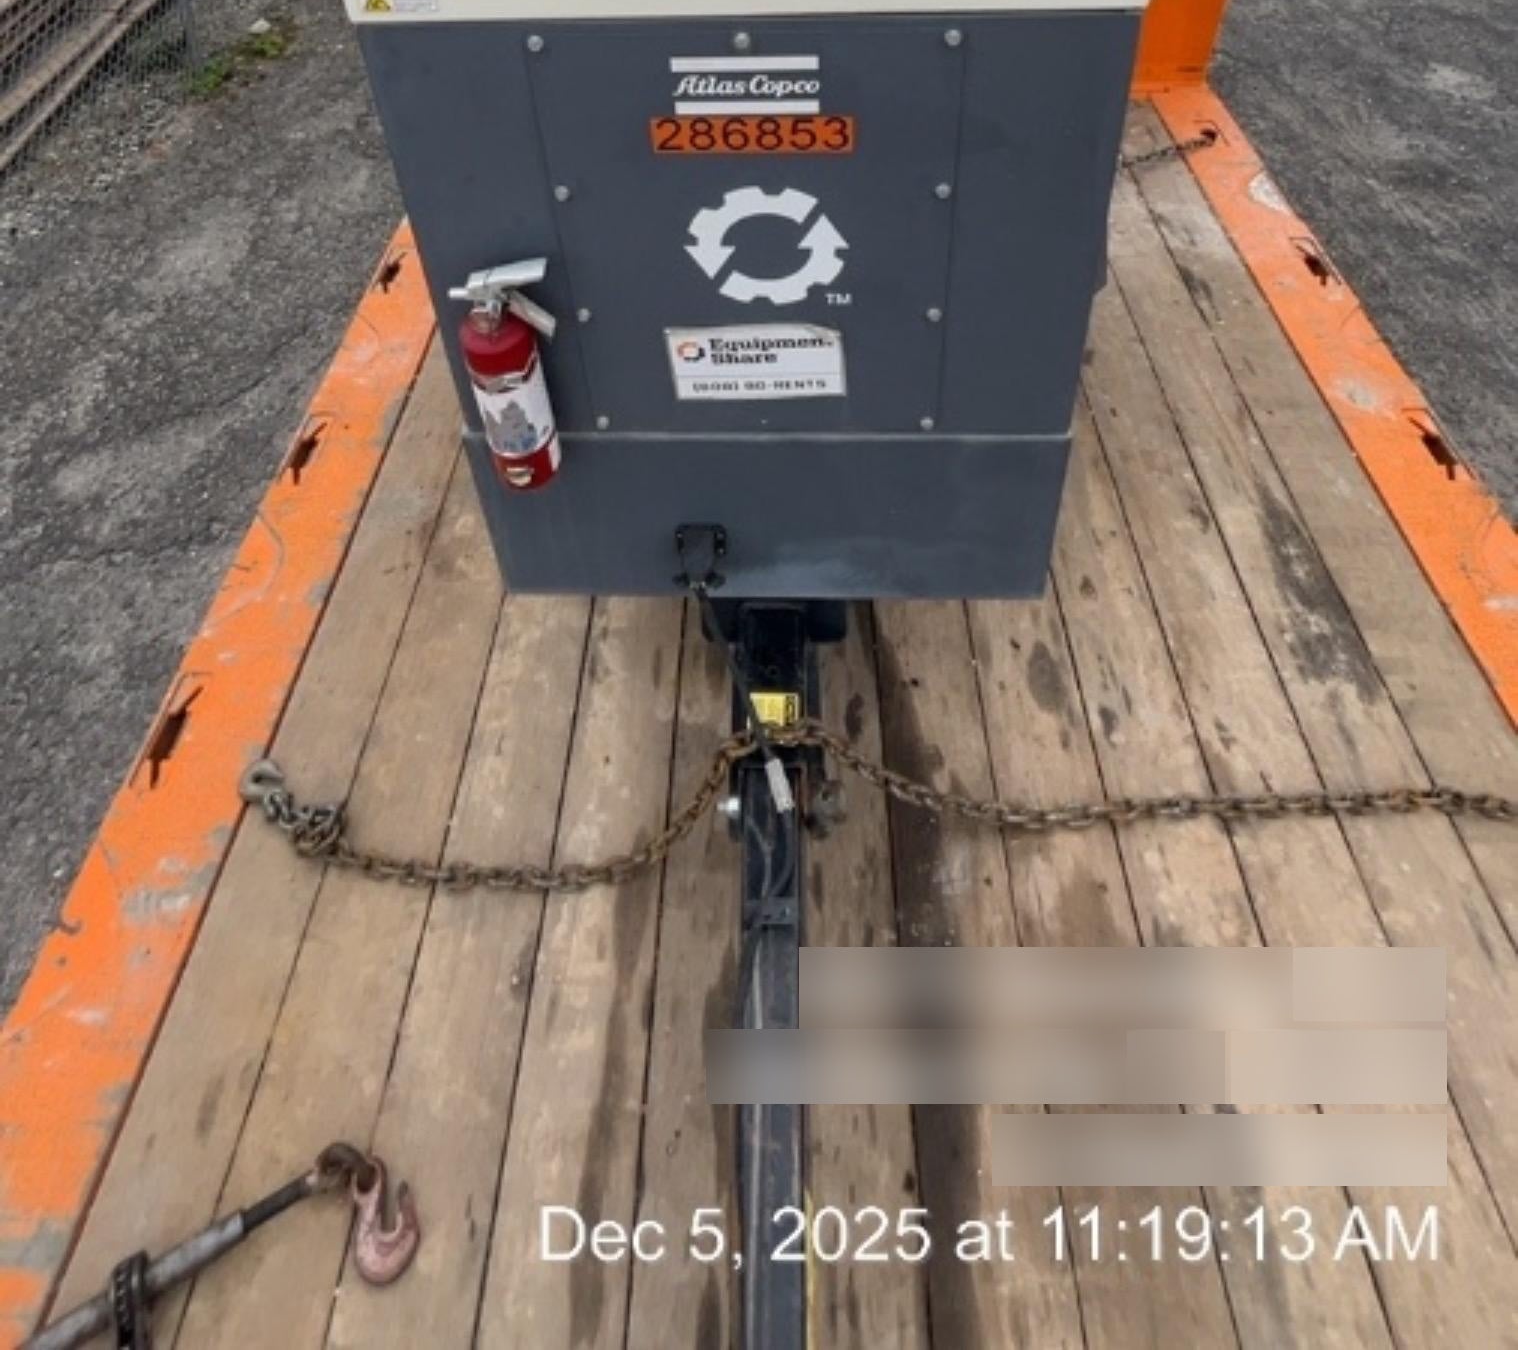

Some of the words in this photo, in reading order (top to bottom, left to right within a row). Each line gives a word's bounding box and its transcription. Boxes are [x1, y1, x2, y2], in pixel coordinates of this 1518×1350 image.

[673, 74, 746, 96] Atlas
[749, 74, 820, 97] Copco
[656, 116, 850, 151] 286853
[825, 293, 852, 305] TM
[711, 353, 778, 365] Share
